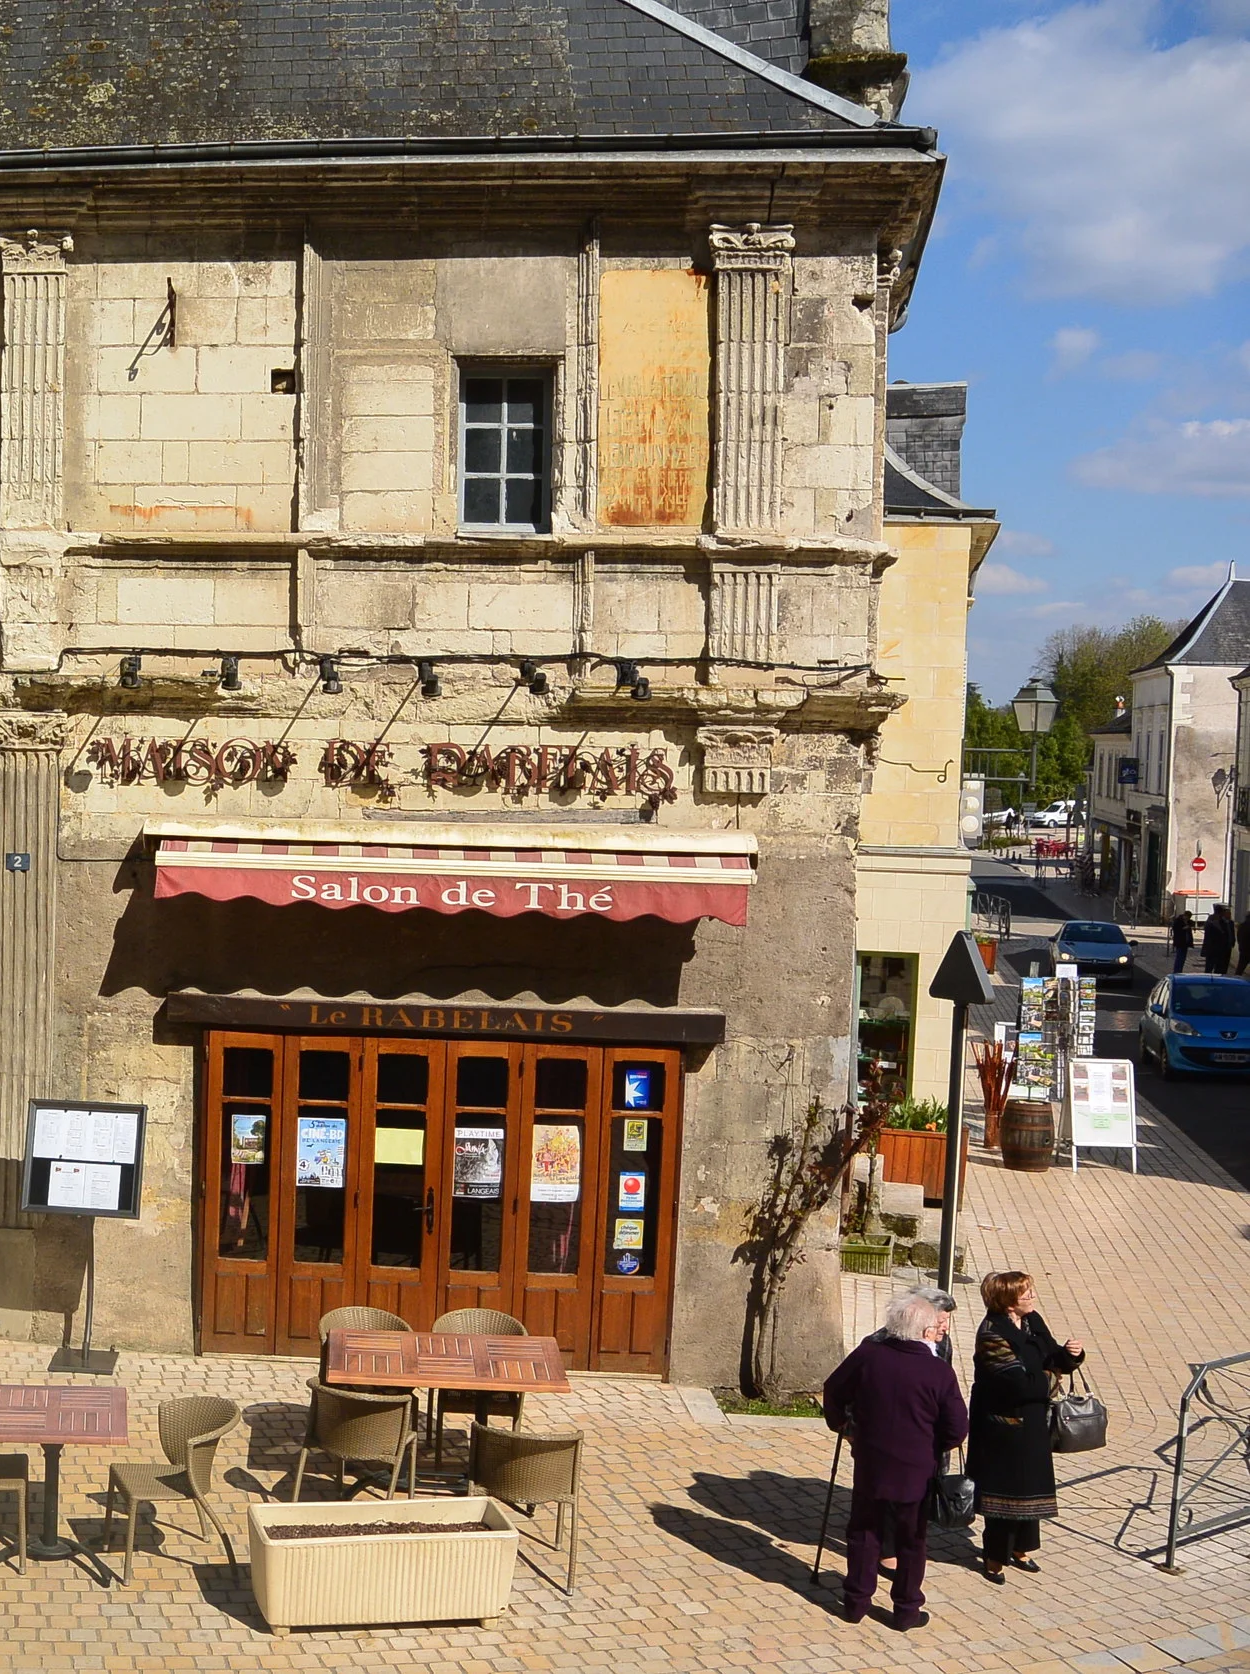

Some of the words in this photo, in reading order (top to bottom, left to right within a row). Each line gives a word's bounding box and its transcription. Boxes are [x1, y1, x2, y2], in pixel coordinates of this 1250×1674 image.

[99, 736, 290, 787] MAISON
[13, 855, 22, 867] 2
[291, 875, 420, 905] Salon
[440, 881, 496, 907] de
[515, 882, 614, 911] Thé
[310, 1004, 347, 1026] Le
[361, 1006, 574, 1033] RABELAIS
[457, 1129, 501, 1138] PLAYTIME
[467, 1187, 500, 1195] LANGEAIS
